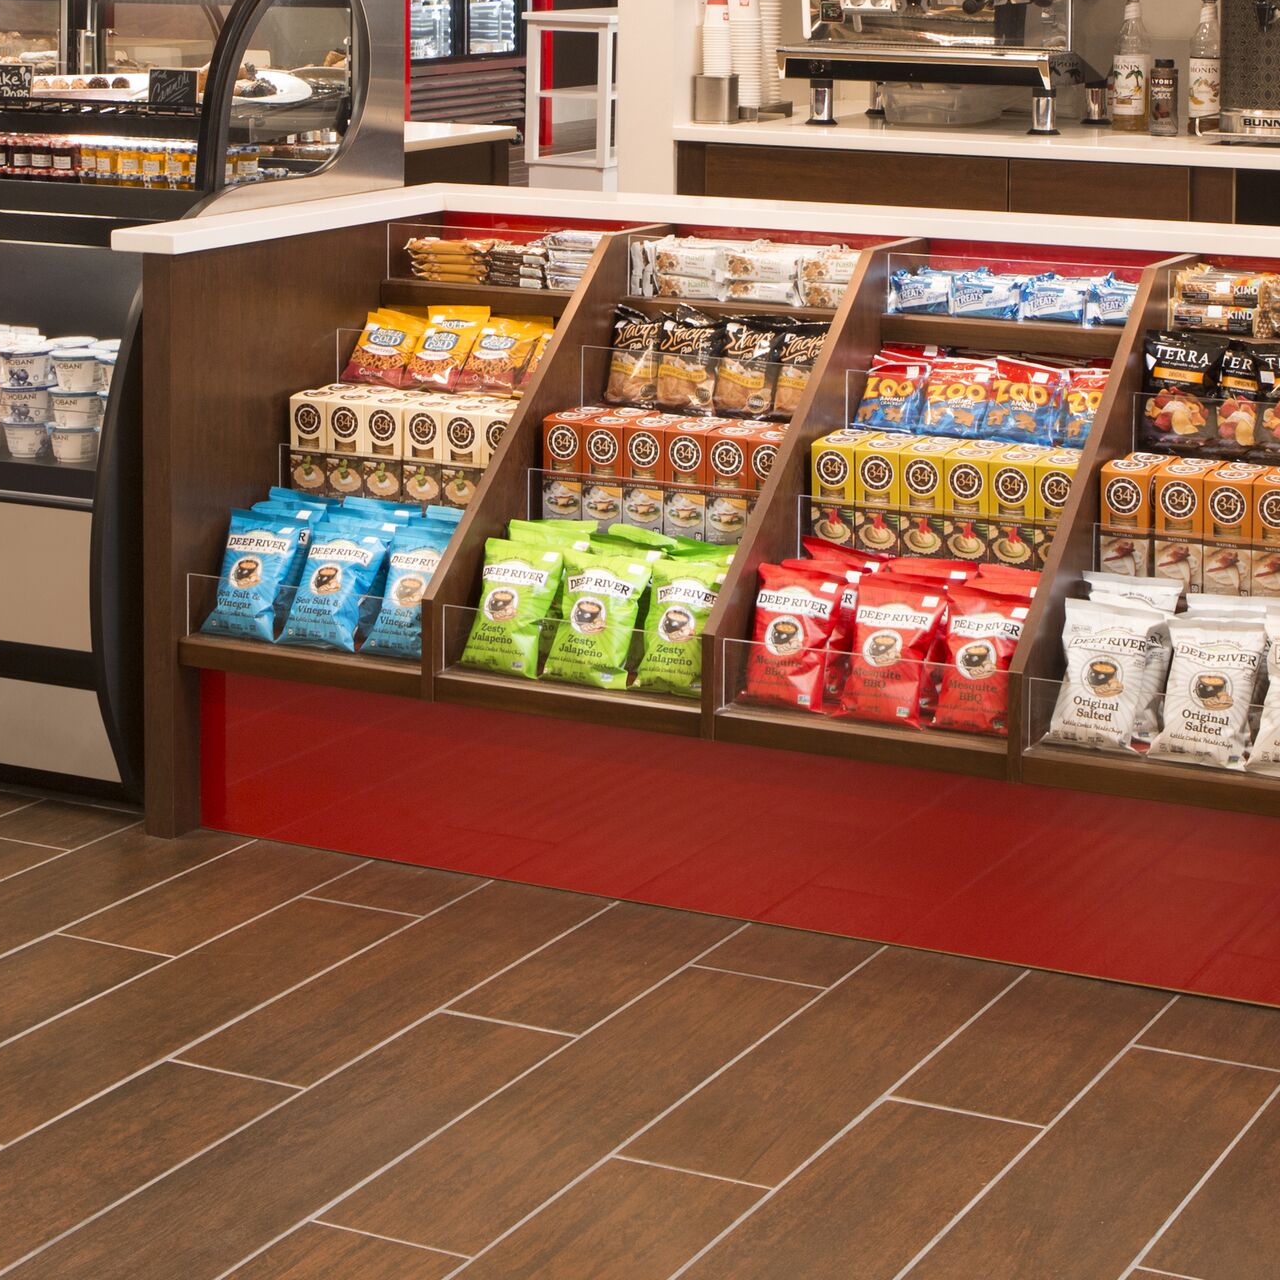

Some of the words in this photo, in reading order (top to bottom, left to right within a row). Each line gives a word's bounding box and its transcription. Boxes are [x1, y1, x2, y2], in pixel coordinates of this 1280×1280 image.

[898, 287, 924, 299] TREATS
[1233, 285, 1258, 295] KIND
[956, 292, 983, 305] TREATS
[1029, 297, 1057, 310] TREATS
[1101, 300, 1125, 312] REATS
[1227, 310, 1254, 321] KIND
[370, 333, 401, 346] GOLD
[426, 339, 455, 350] GOLD
[1155, 344, 1210, 365] TERRA
[865, 377, 914, 398] ZOO
[928, 383, 987, 403] ZOO
[993, 380, 1050, 405] ZOO
[228, 536, 255, 548] DEEP
[255, 537, 287, 551] RIVER
[310, 545, 336, 556] DEEP
[335, 549, 370, 564] RIVER
[391, 554, 417, 565] DEEP
[419, 557, 438, 568] RIV
[483, 566, 509, 579] DEEP
[511, 570, 544, 584] RIVER
[570, 576, 593, 590] DEEP
[594, 577, 631, 596] RIVER
[295, 596, 310, 605] Sea
[312, 597, 330, 606] Salt
[659, 587, 682, 601] DEEP
[218, 598, 251, 610] Vinegar
[297, 605, 331, 616] Vinegar
[758, 592, 791, 608] DEEP
[791, 597, 828, 615] RIVER
[380, 615, 414, 628] Vinegar
[858, 609, 890, 622] DEEP
[891, 612, 928, 626] RIVER
[481, 622, 506, 634] Zesty
[953, 618, 986, 632] DEEP
[987, 621, 1020, 637] RIVER
[567, 634, 597, 647] Zesty
[1074, 636, 1107, 647] DEEP
[1108, 636, 1147, 653] RIVER
[656, 643, 685, 656] Zesty
[1178, 644, 1216, 661] DEEP
[1217, 651, 1257, 668] RIVER
[959, 692, 983, 703] BBQ
[1073, 695, 1120, 712] Original
[1076, 707, 1112, 722] Salted
[1182, 708, 1230, 727] Original
[1185, 721, 1222, 736] Salted
